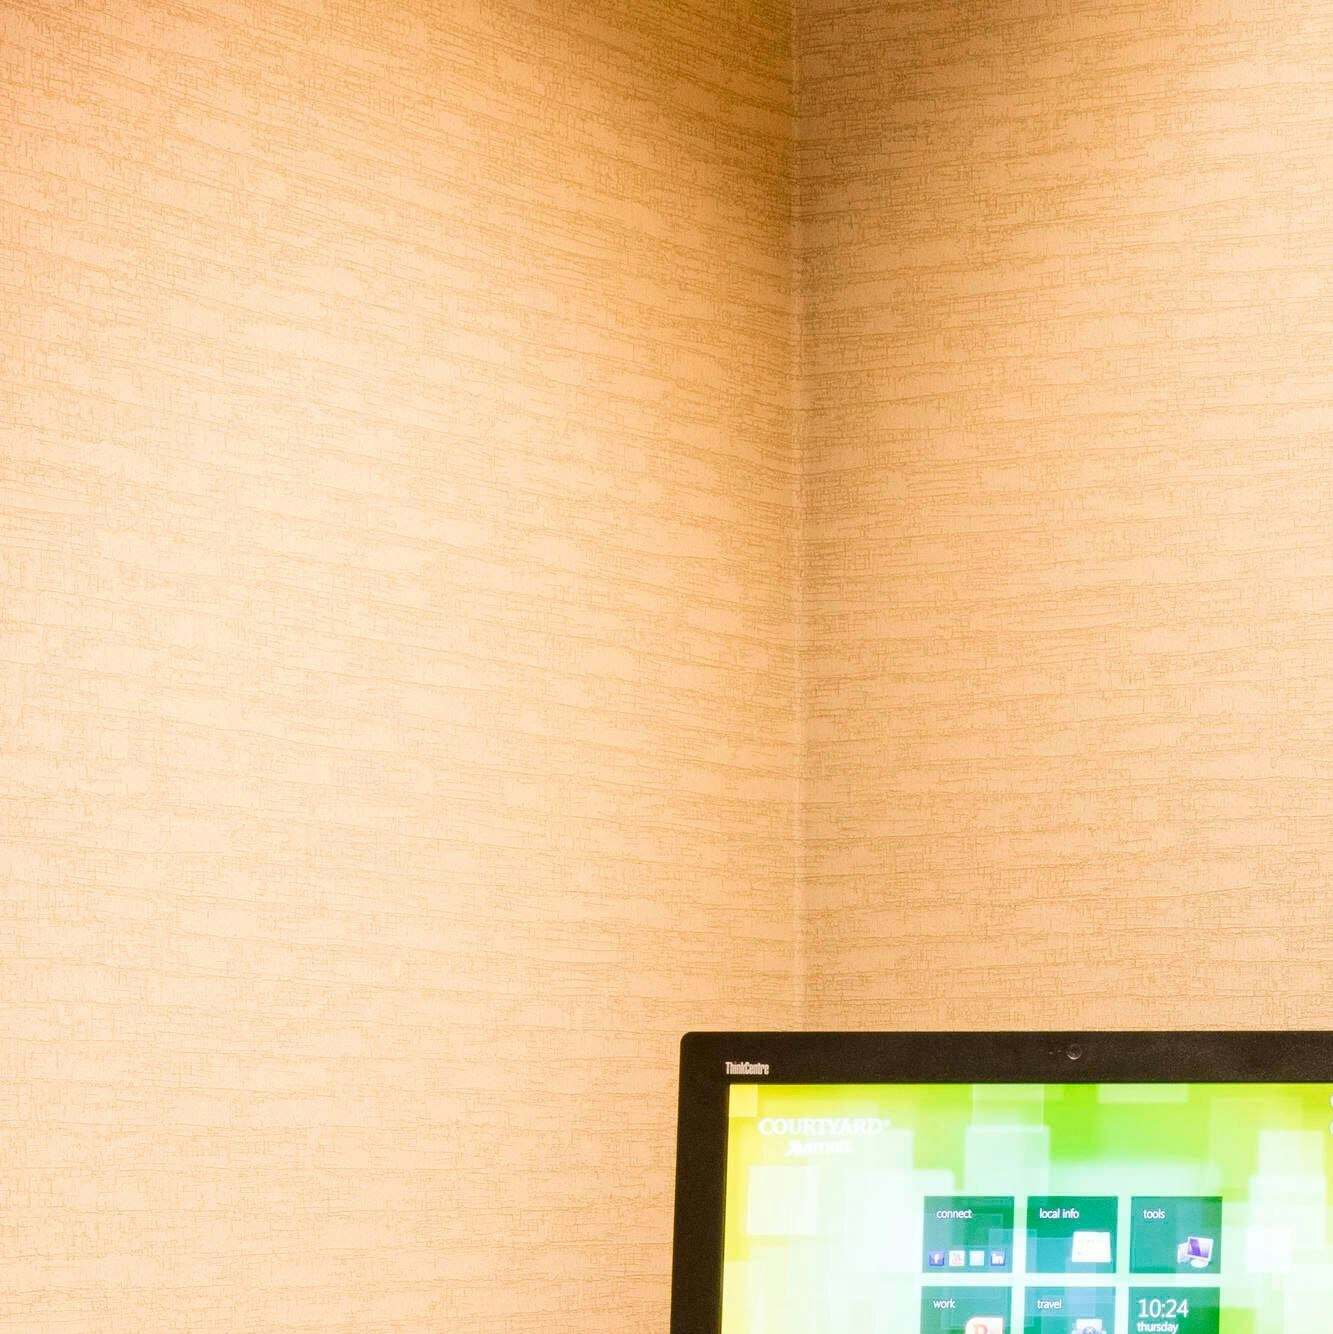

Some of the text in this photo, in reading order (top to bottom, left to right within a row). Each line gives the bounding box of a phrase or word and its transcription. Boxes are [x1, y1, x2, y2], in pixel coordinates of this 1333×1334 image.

[725, 1061, 770, 1076] ThinkCentre
[936, 1208, 972, 1219] connect
[1039, 1208, 1080, 1219] local info
[1143, 1208, 1166, 1219] tools
[933, 1298, 956, 1310] work
[1037, 1298, 1063, 1310] travel
[1138, 1299, 1189, 1318] 10:24
[1136, 1321, 1179, 1334] thursday
